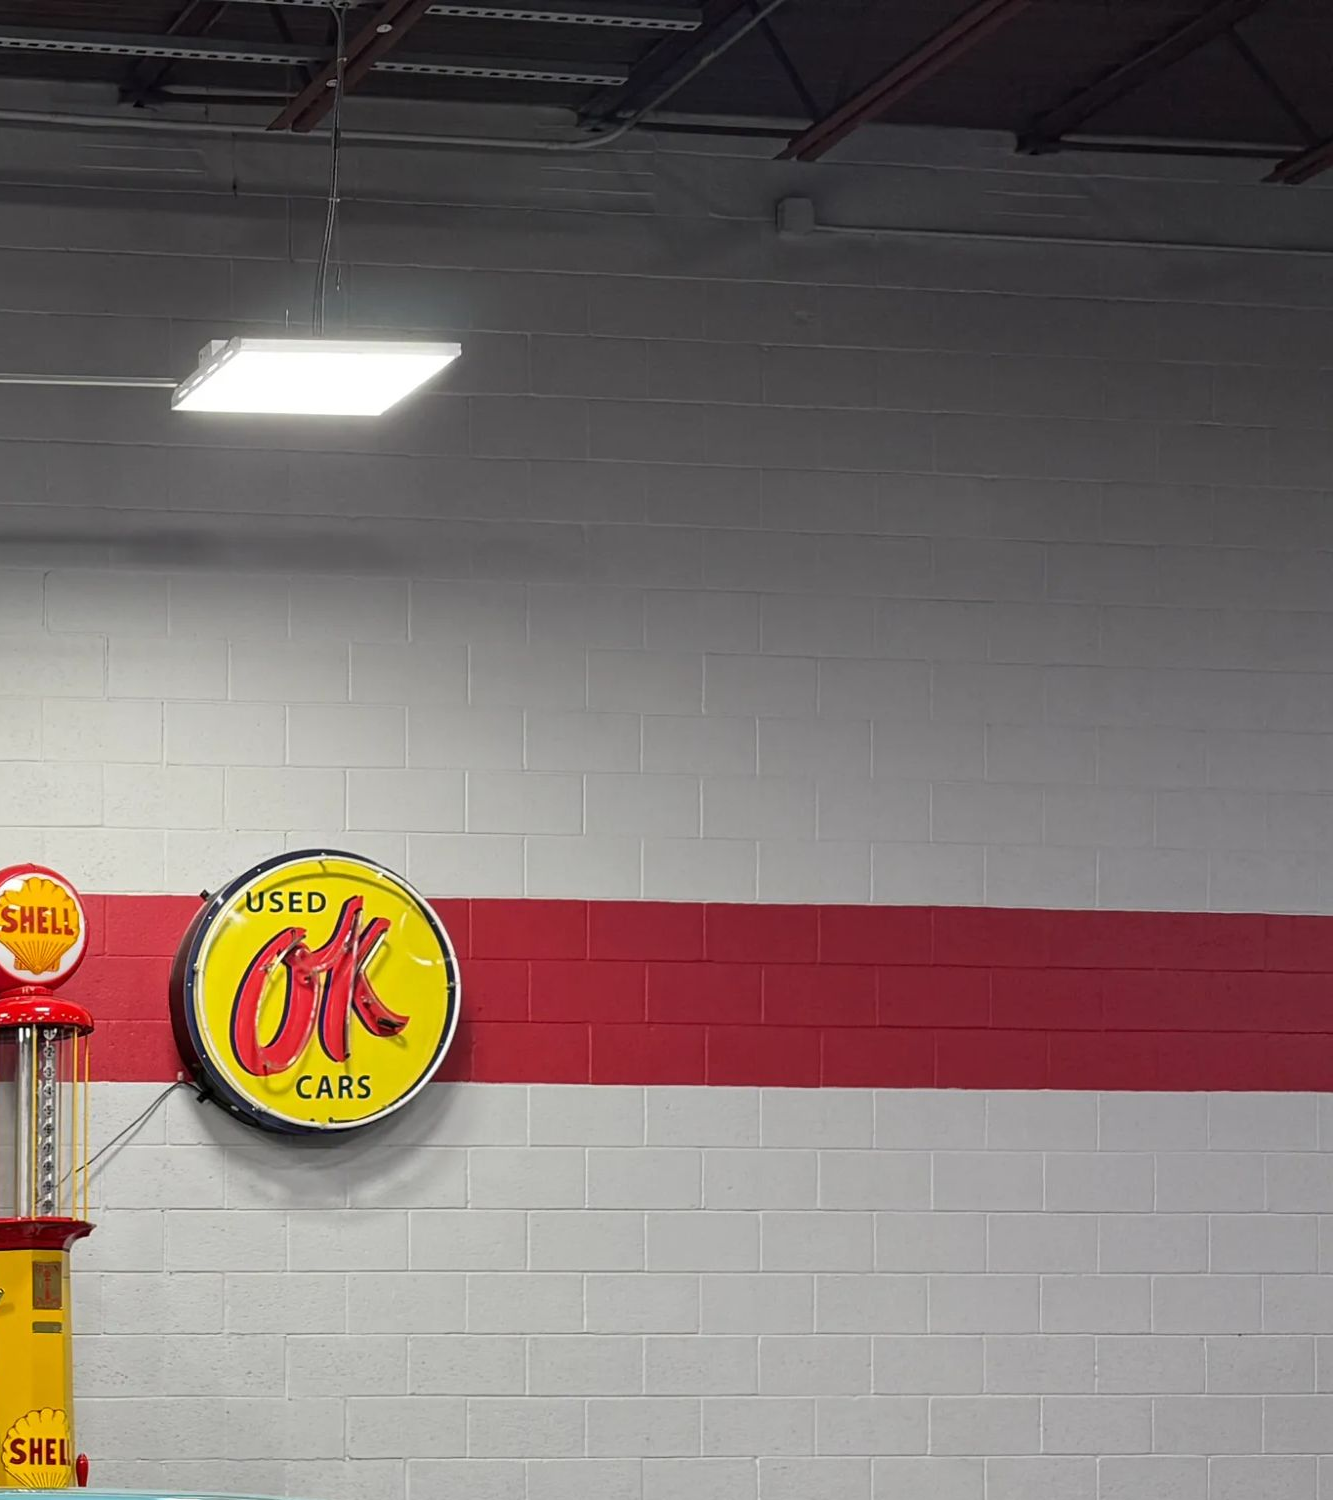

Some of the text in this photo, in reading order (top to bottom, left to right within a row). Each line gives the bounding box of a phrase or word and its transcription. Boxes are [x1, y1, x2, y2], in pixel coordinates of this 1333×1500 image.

[245, 891, 327, 913] USED
[1, 906, 75, 936] SHELL
[229, 895, 411, 1077] OK
[295, 1074, 372, 1099] CARS
